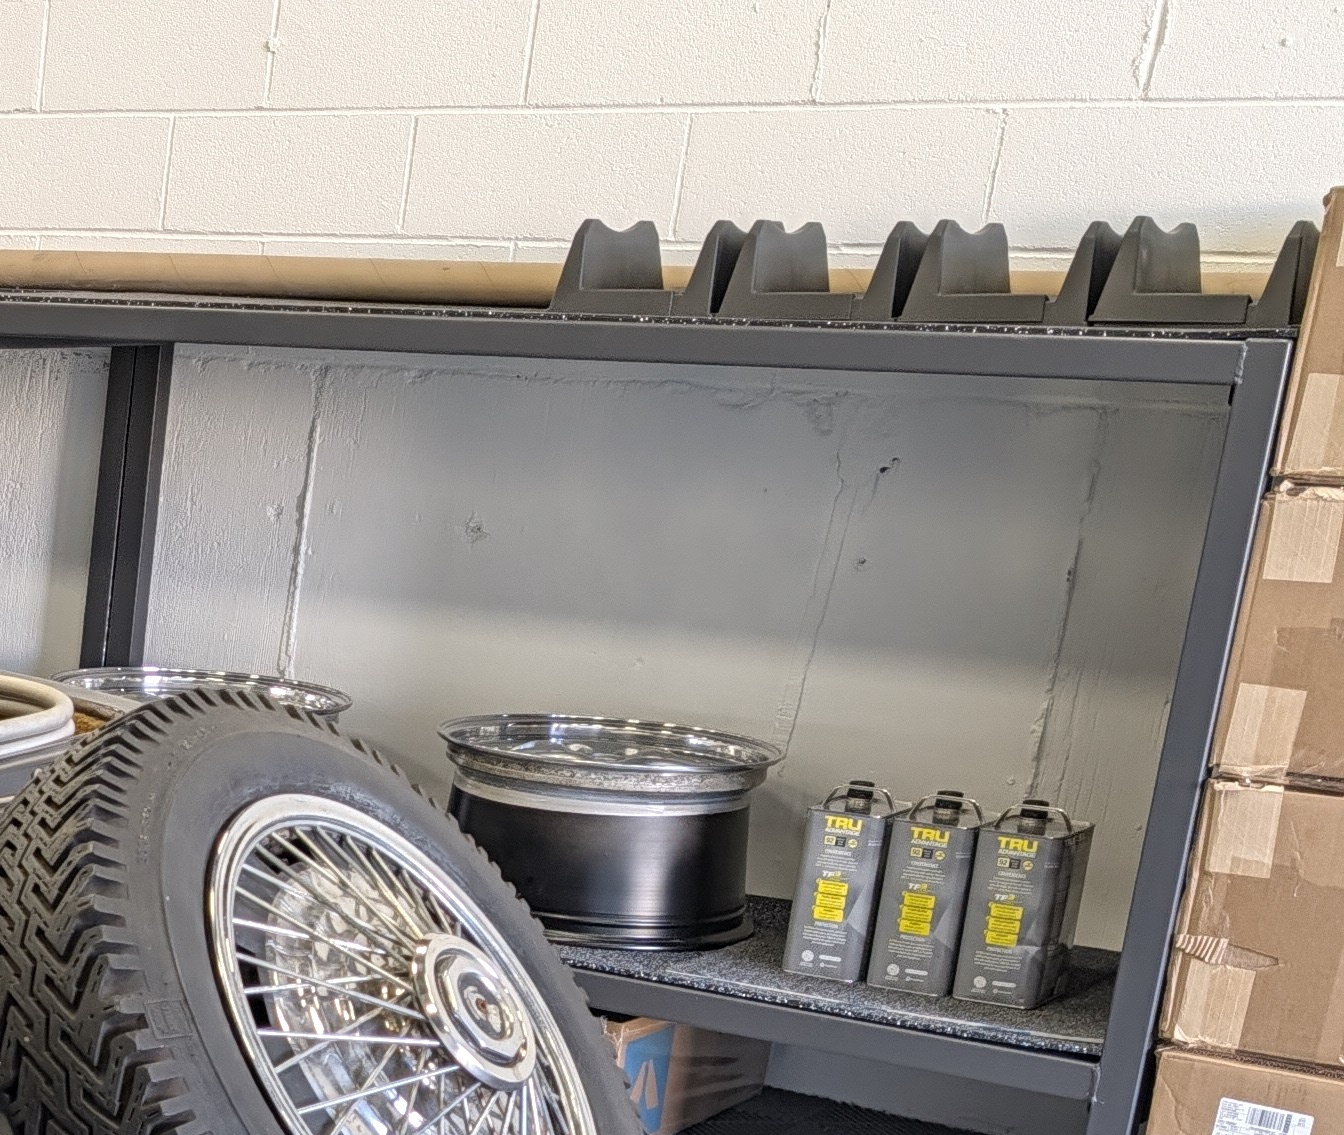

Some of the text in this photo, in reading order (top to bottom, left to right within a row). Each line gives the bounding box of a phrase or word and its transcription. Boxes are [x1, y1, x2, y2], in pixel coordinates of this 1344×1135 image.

[825, 815, 862, 830] TRU
[911, 827, 950, 843] TRU
[997, 836, 1039, 852] TRU
